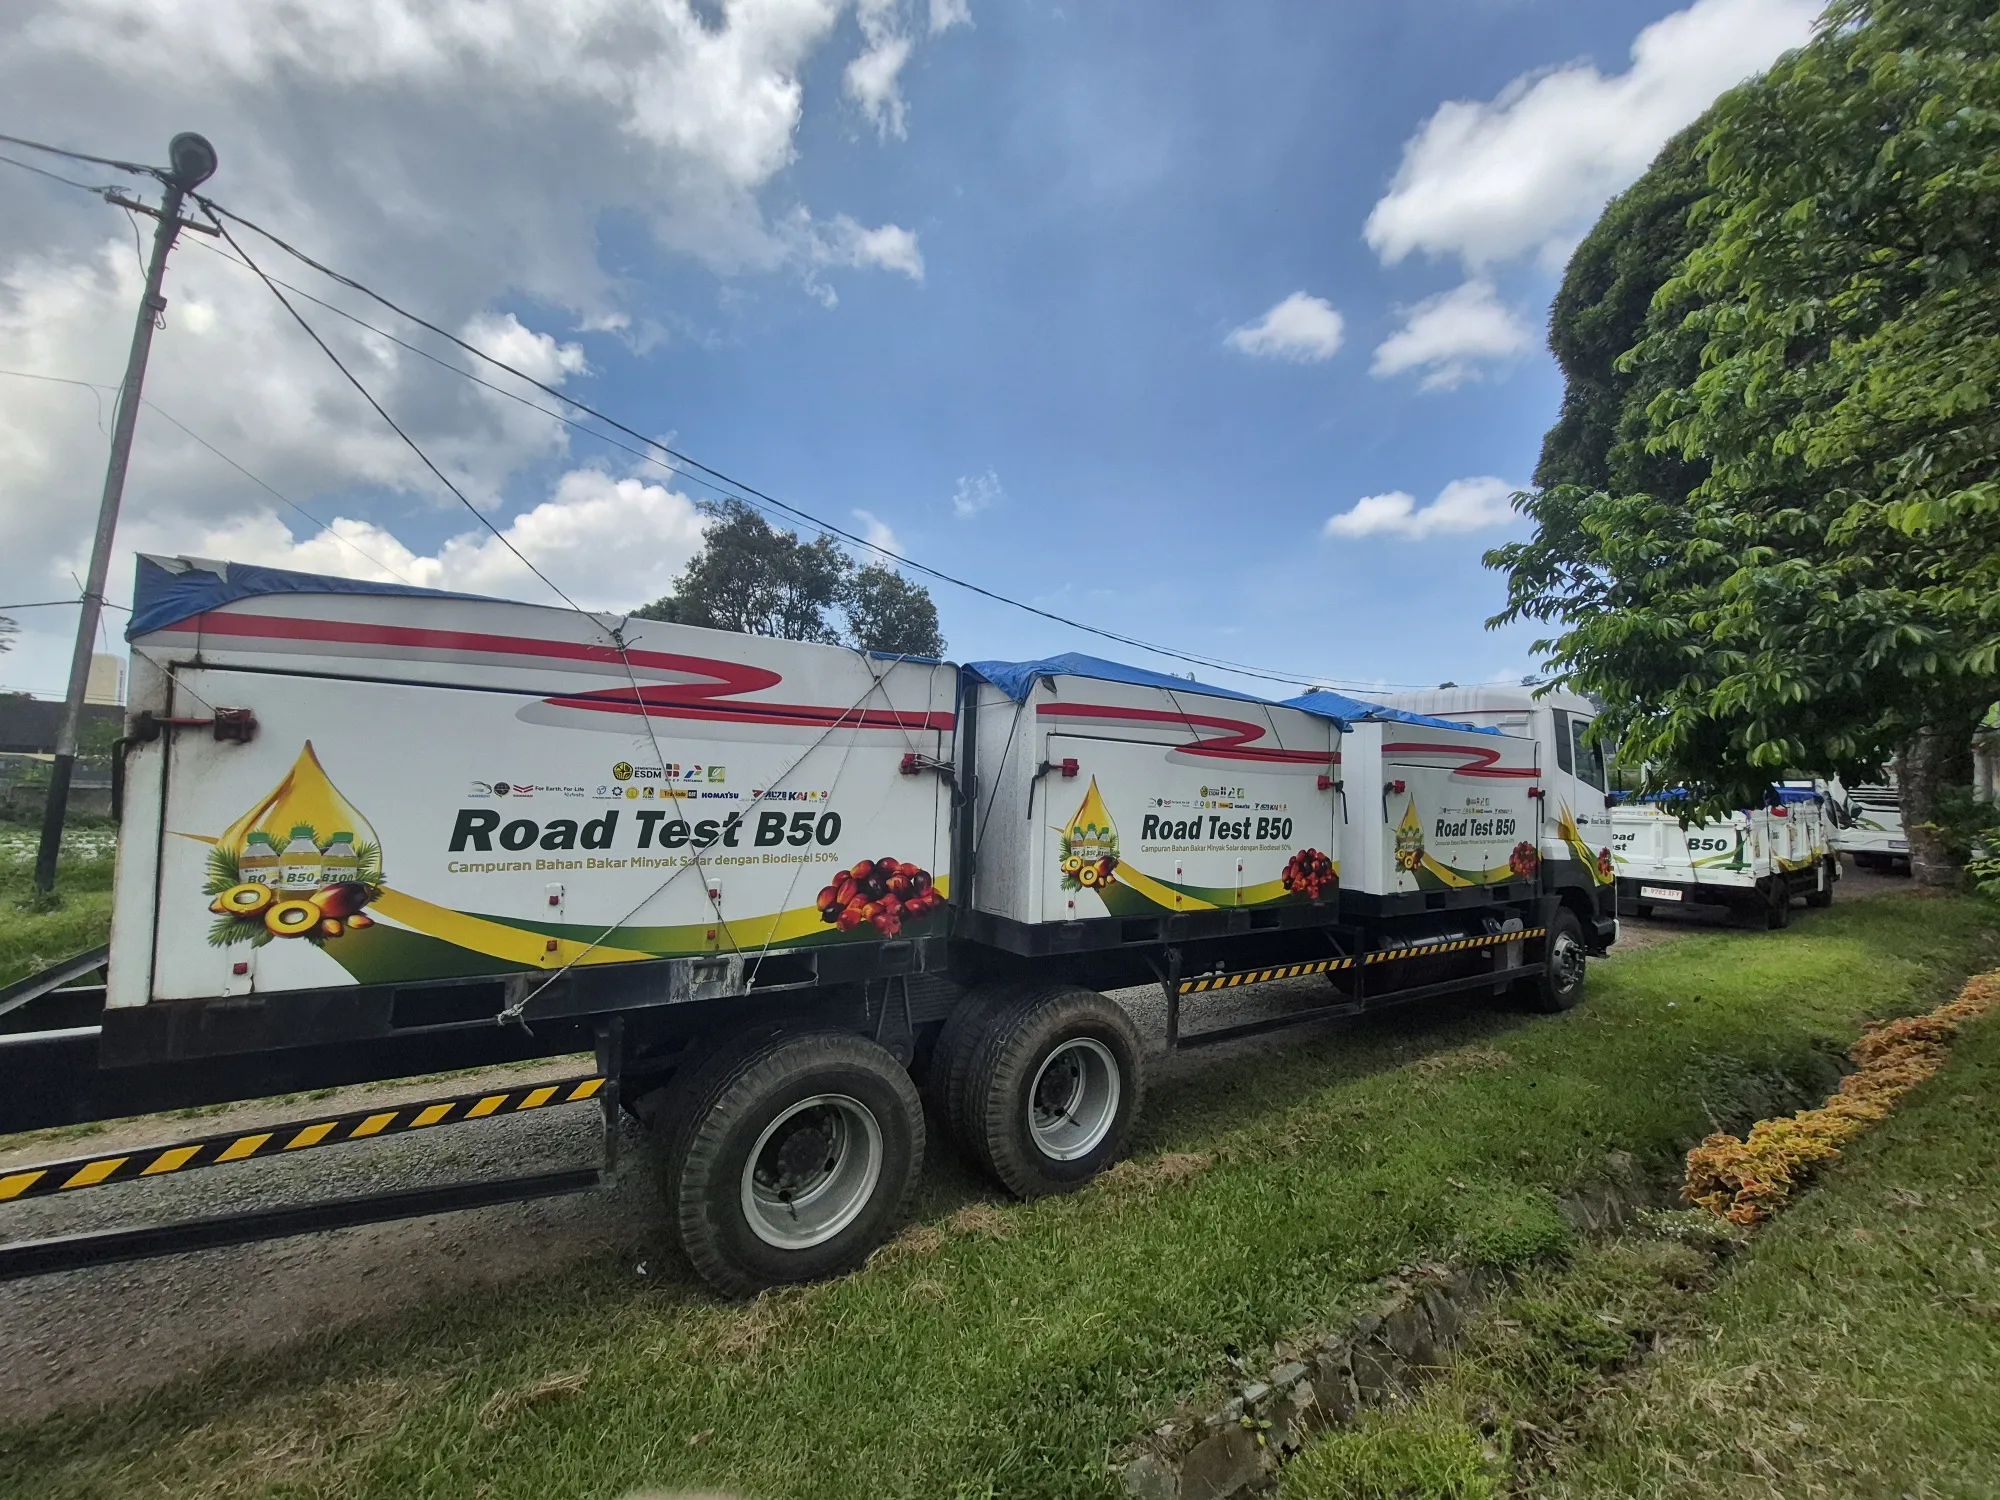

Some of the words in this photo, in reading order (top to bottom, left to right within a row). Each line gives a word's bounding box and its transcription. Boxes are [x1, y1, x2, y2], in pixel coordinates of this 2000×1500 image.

[634, 770, 662, 778] ESDM
[448, 808, 620, 852] Road
[635, 810, 743, 848] Test
[754, 811, 842, 847] B50
[1141, 814, 1203, 840] Road
[1208, 816, 1251, 840] Test
[1256, 817, 1293, 840] B50
[1435, 819, 1468, 837] Road
[1470, 819, 1493, 836] Test
[1496, 819, 1516, 835] B50
[1688, 838, 1728, 851] B50
[448, 860, 532, 874] Campuran
[536, 859, 582, 870] Bahan
[586, 858, 627, 869] Bakar
[631, 856, 677, 868] Minyak
[715, 855, 758, 867] dengan
[762, 853, 812, 864] Biodiesel
[815, 852, 839, 862] 50%
[248, 874, 266, 883] B0
[286, 873, 314, 882] B50
